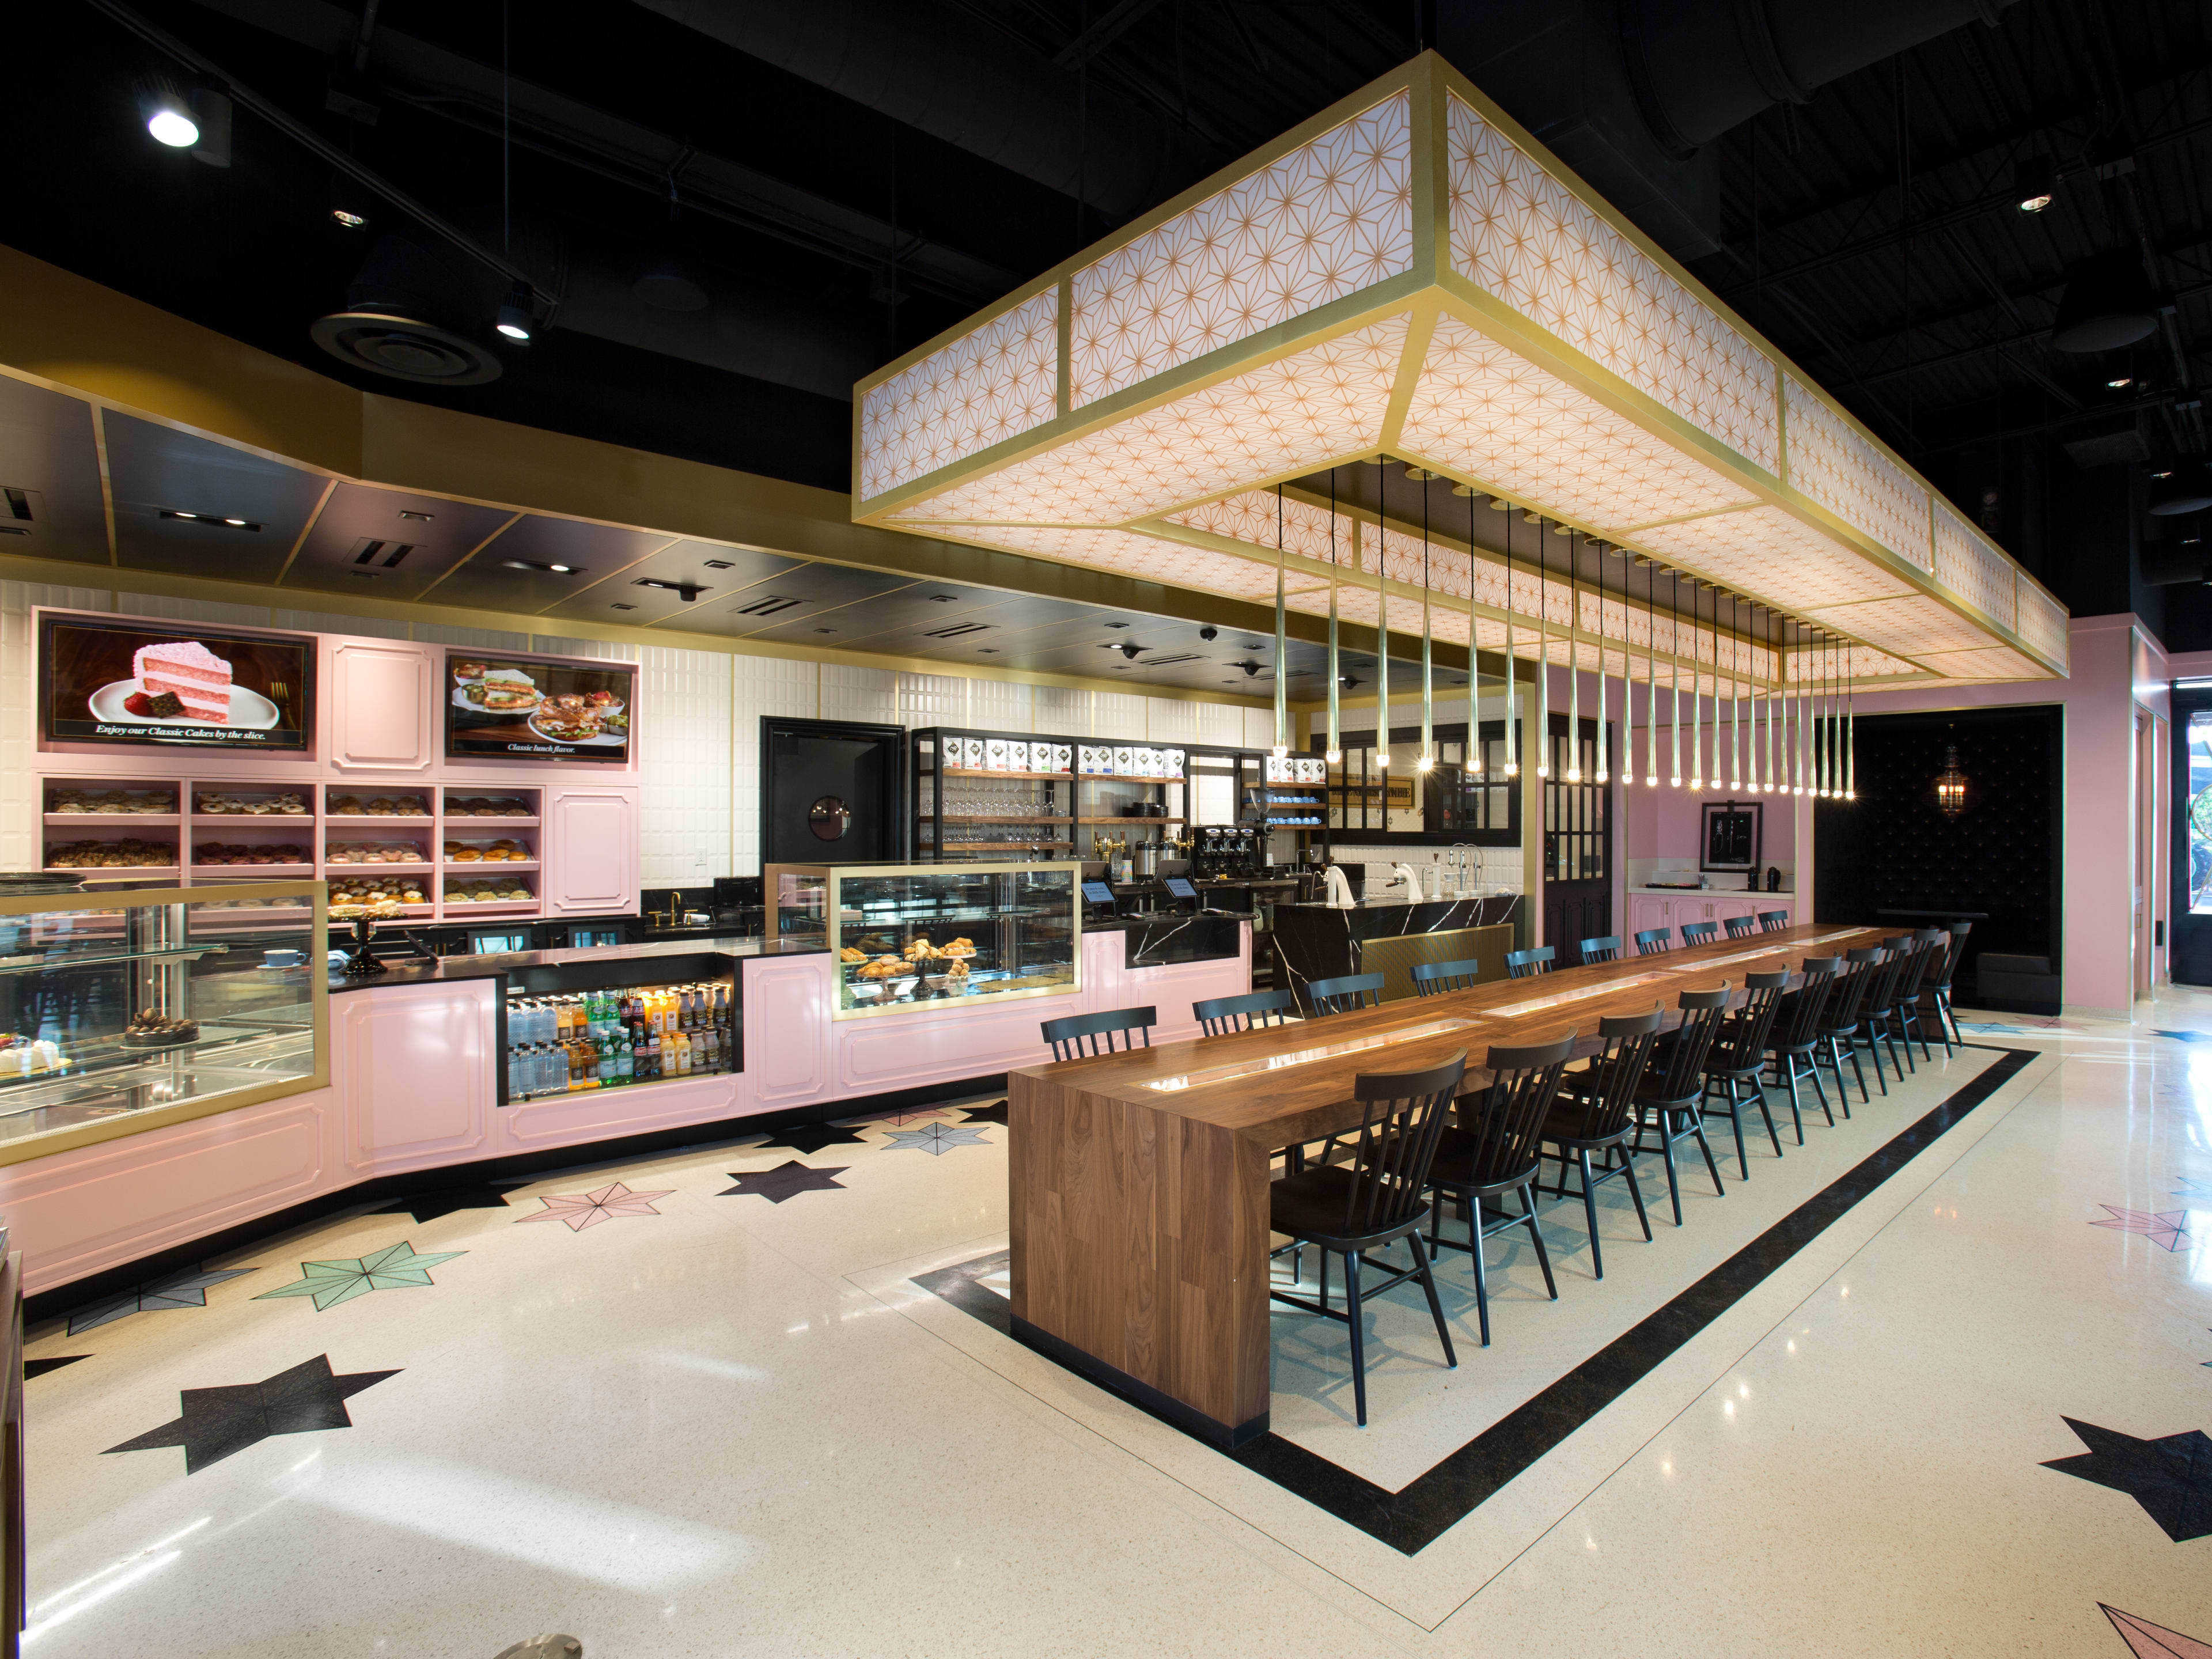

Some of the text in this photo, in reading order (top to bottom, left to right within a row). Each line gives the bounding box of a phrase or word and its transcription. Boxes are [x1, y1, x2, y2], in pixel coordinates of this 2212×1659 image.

[96, 725, 127, 736] Enjoy
[148, 728, 184, 737] Classic
[185, 729, 214, 738] Cakes
[214, 730, 227, 739] by
[552, 745, 575, 753] flavor.
